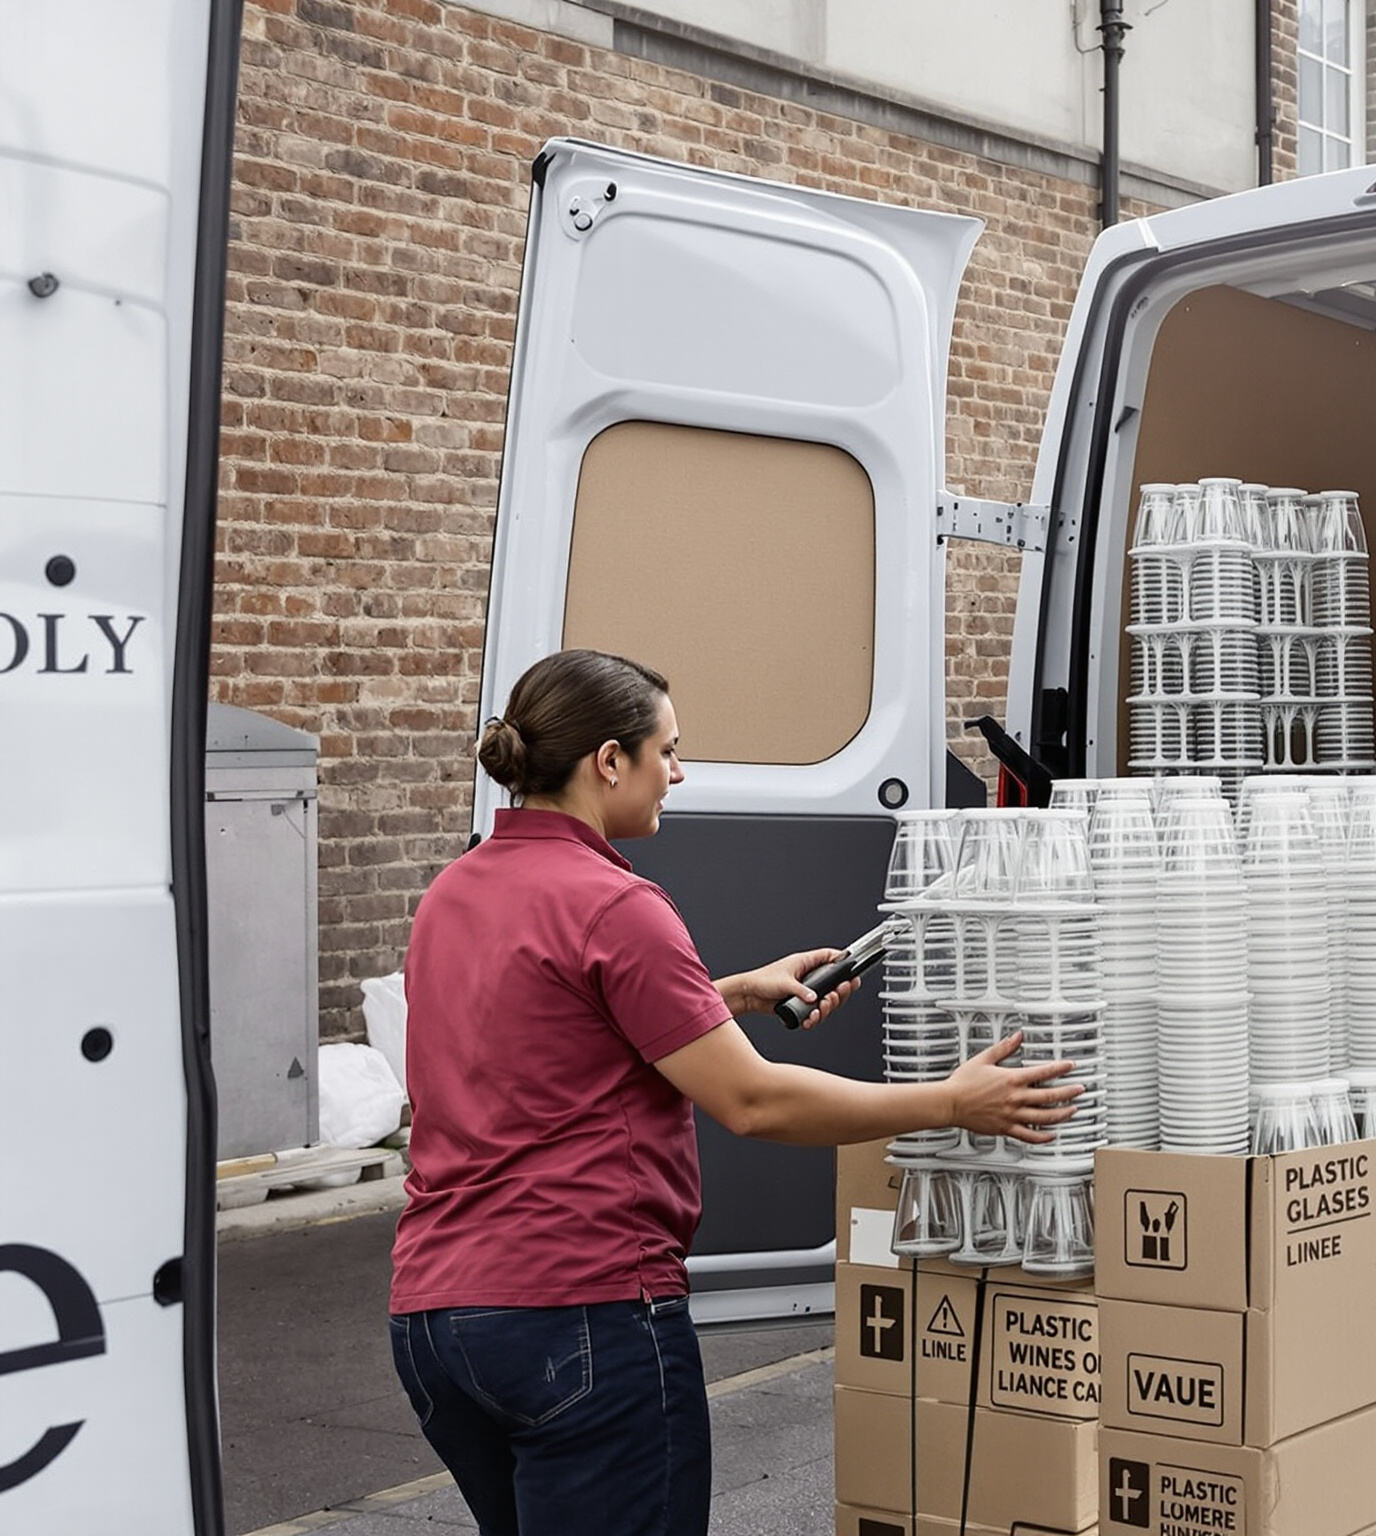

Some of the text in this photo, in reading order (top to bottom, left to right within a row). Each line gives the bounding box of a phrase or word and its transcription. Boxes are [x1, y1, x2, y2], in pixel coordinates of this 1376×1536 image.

[1286, 1155, 1369, 1192] PLASTIC
[1287, 1186, 1370, 1223] GLASES
[1006, 1310, 1092, 1341] PLASTIC
[922, 1338, 967, 1362] LINLE
[1009, 1341, 1076, 1371] WINES
[999, 1370, 1068, 1399] LIANCE
[1134, 1369, 1216, 1410] VAUE
[1161, 1476, 1237, 1505] PLASTIC
[1160, 1501, 1236, 1530] LOMERE
